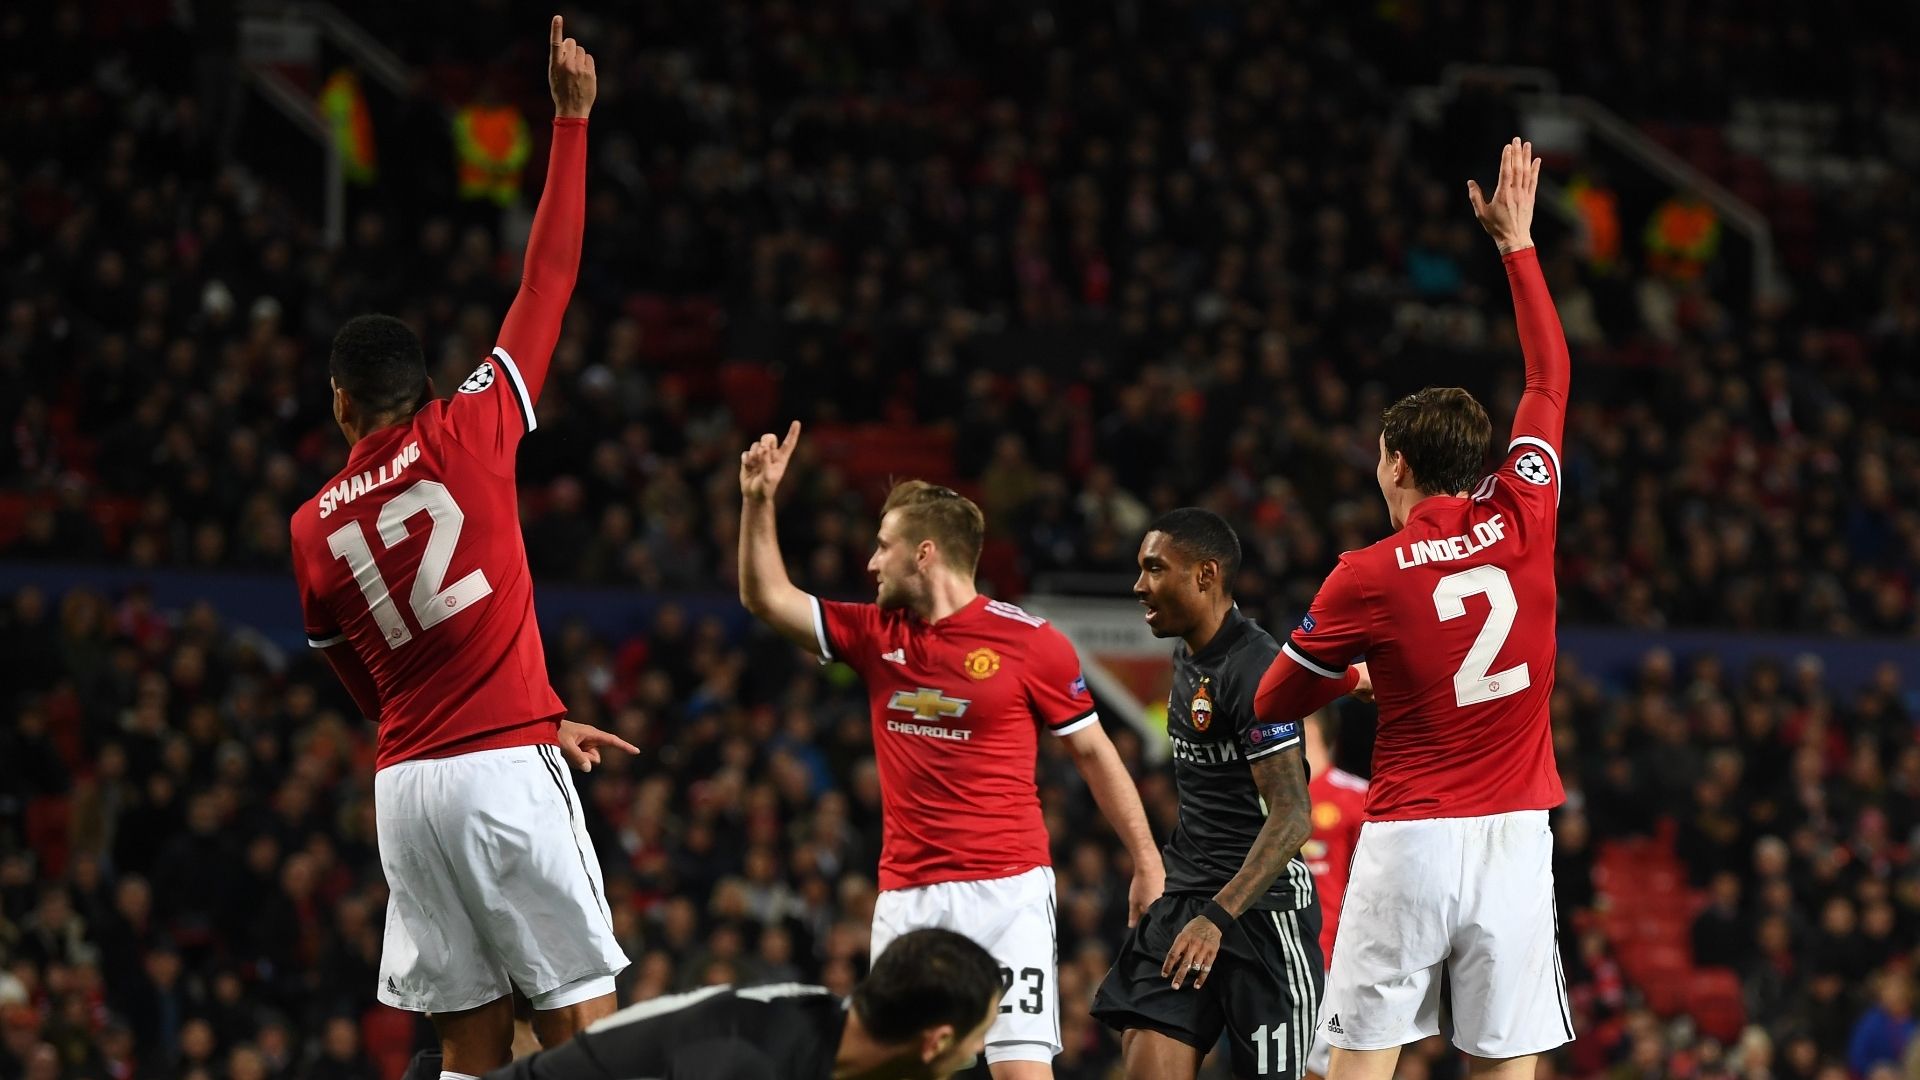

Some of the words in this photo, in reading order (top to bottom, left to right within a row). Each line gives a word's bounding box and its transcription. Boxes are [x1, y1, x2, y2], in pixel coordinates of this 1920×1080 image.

[319, 440, 421, 519] SMALLING
[327, 479, 493, 650] 12
[1395, 513, 1505, 570] LINDELOF
[1432, 564, 1531, 708] 2
[886, 720, 972, 741] CHEVROLET
[1262, 722, 1294, 738] RESPECT
[998, 966, 1045, 1015] 23
[1250, 1022, 1288, 1075] 11
